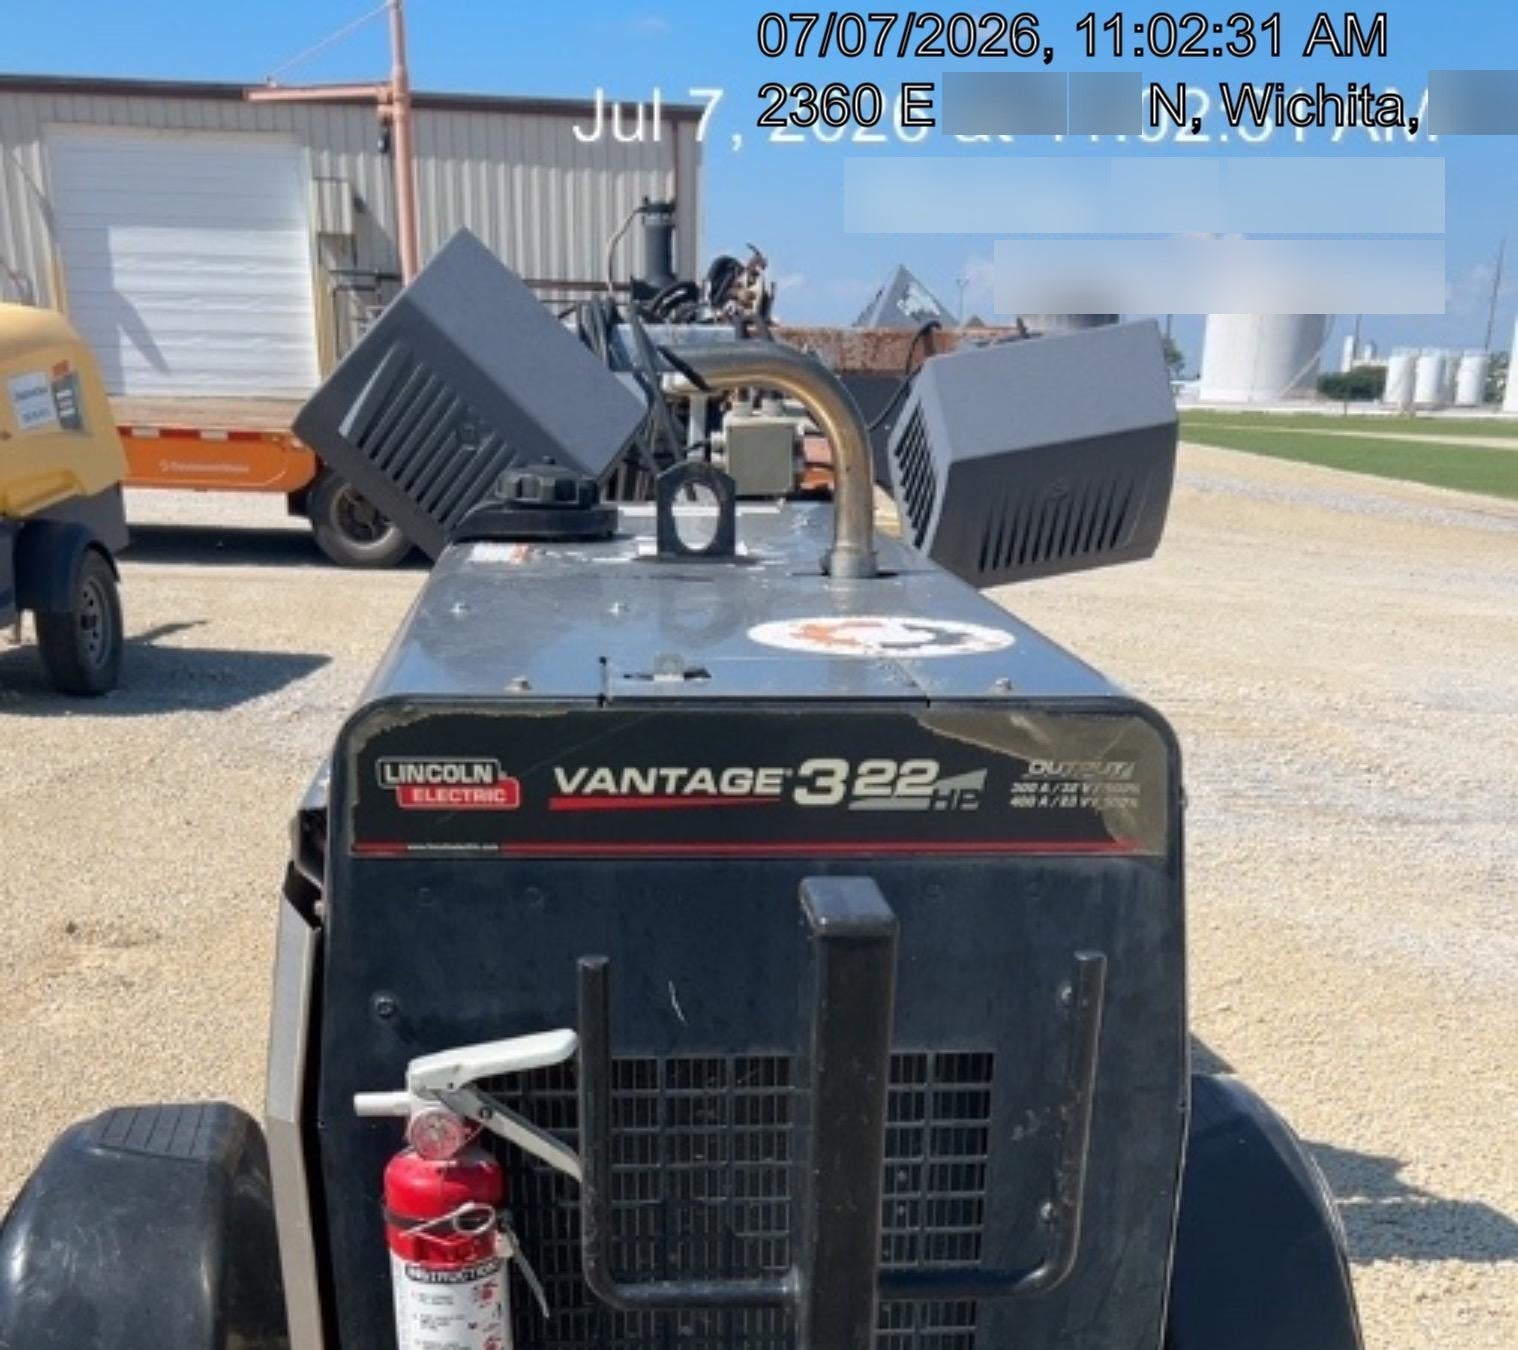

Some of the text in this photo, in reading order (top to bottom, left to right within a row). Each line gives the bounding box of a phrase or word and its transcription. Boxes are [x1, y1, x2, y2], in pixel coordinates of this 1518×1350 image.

[384, 763, 493, 784] LINCOLN
[554, 767, 784, 795] VANTAGE
[794, 758, 940, 805] 322
[413, 788, 507, 803] ELECTRIC
